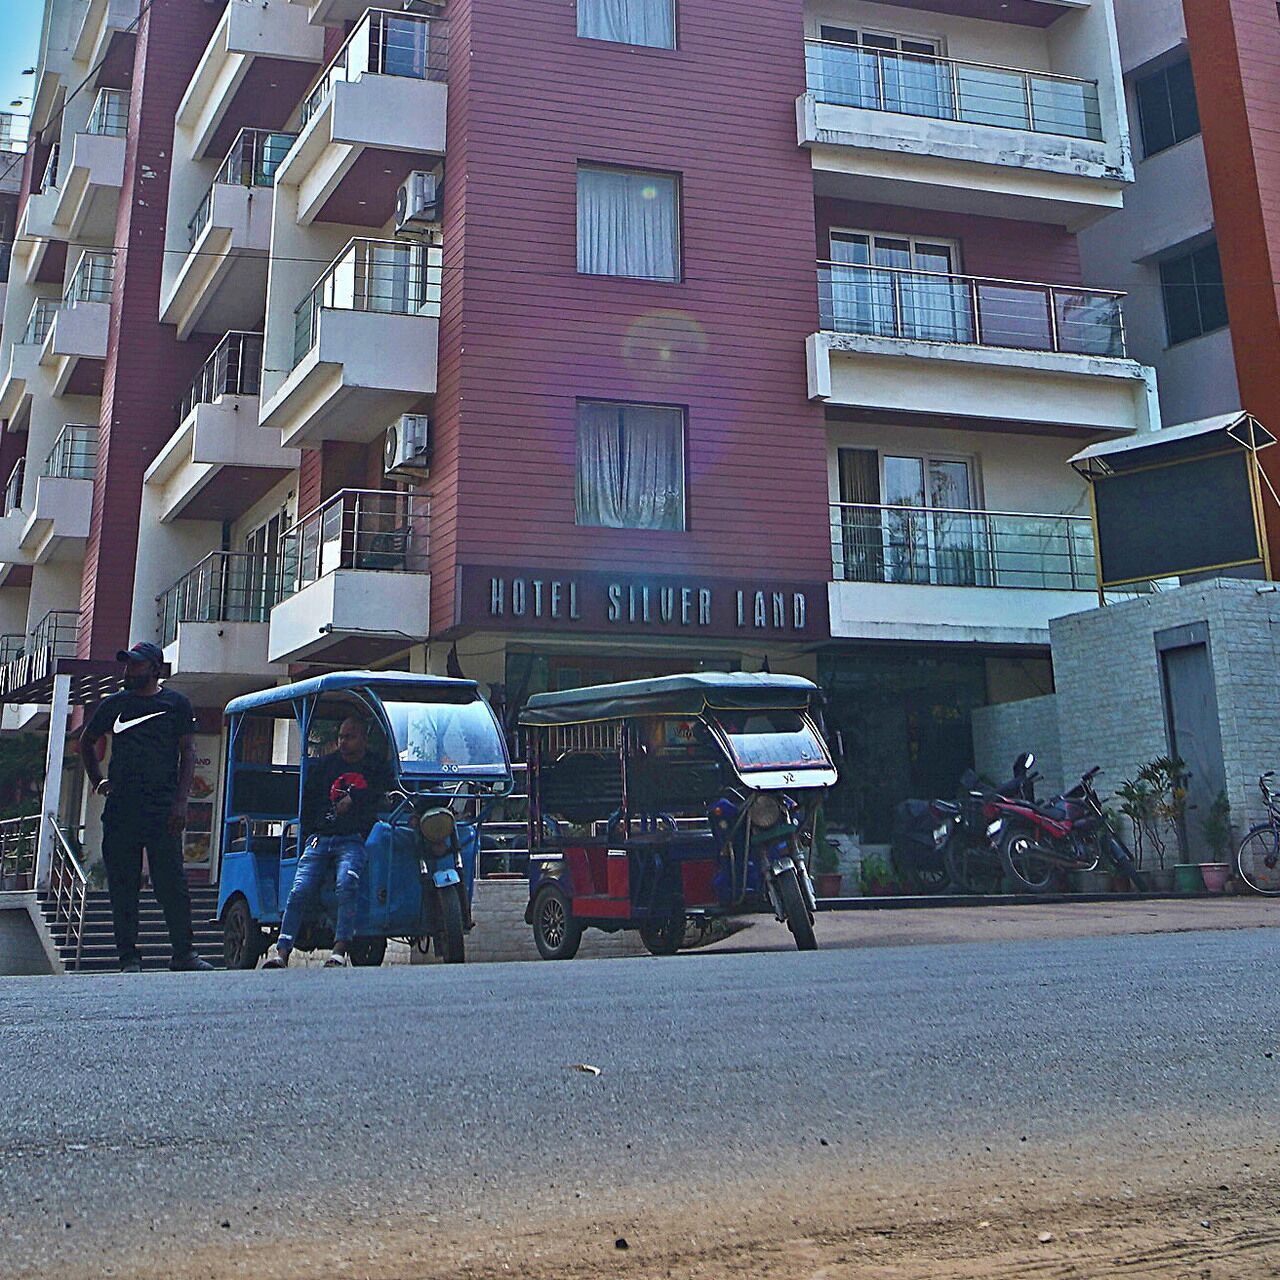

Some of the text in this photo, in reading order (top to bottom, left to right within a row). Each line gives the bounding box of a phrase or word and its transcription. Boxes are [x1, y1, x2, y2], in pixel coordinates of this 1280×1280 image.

[490, 577, 807, 630] HOTEL SILVER LAND
